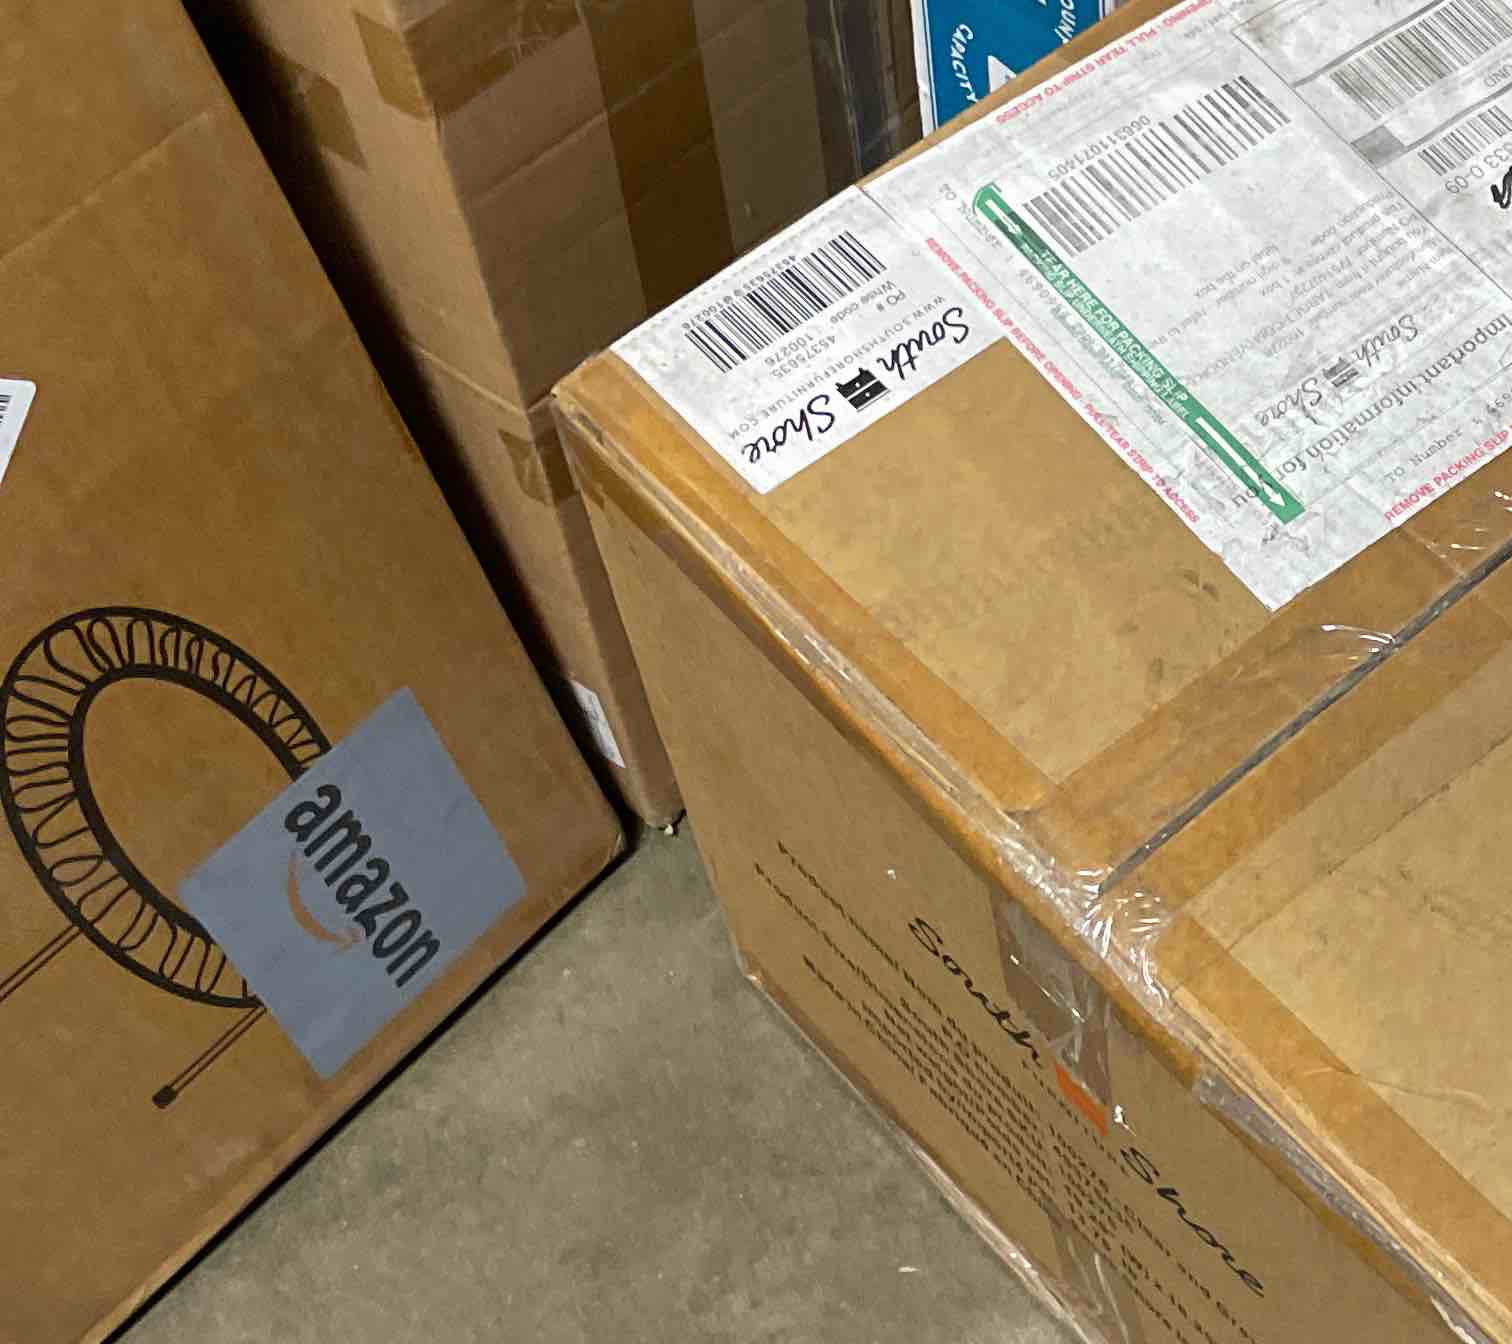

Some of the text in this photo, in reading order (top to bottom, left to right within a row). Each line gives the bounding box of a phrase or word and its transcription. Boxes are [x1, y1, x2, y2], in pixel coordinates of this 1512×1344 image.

[949, 23, 978, 106] CAPACITY
[882, 288, 907, 306] PO
[872, 304, 982, 383] South
[1094, 306, 1121, 332] FOR
[1115, 328, 1166, 379] PACKING
[1161, 376, 1190, 404] SLIP
[1347, 310, 1426, 373] South
[734, 391, 850, 473] Shore
[1252, 374, 1330, 438] Shore
[1302, 375, 1421, 464] information
[1270, 451, 1309, 485] for
[1382, 480, 1436, 524] REMOVE
[1432, 445, 1487, 489] PACKING
[1482, 427, 1512, 455] SLIP
[284, 782, 443, 991] amazon
[908, 915, 1266, 1299] South Shore
